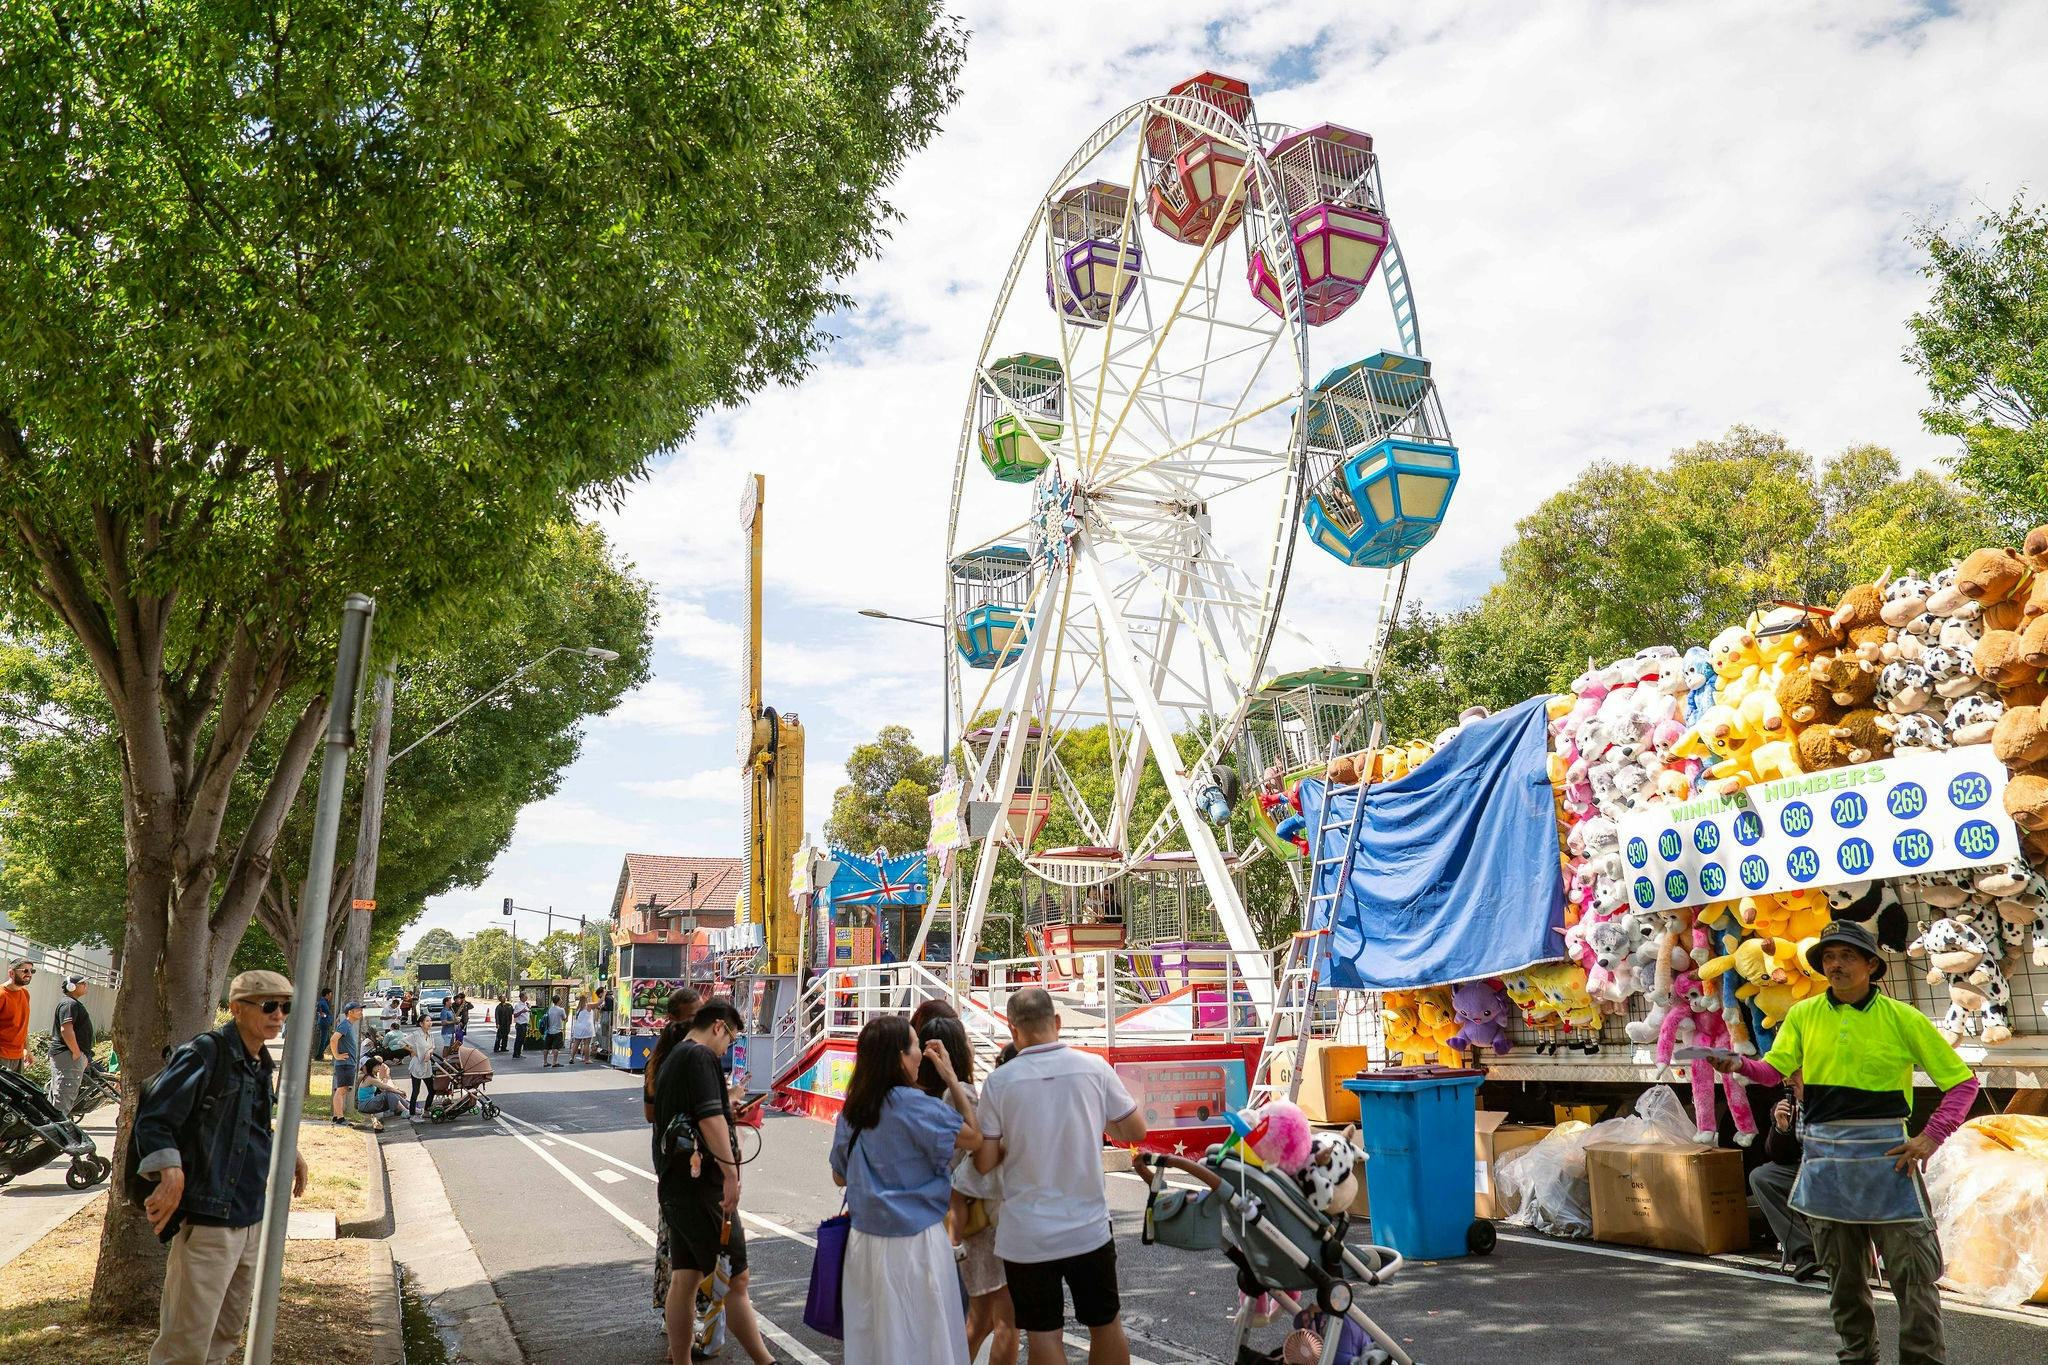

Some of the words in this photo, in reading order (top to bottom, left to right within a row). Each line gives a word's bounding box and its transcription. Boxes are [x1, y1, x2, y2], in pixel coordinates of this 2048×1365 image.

[1628, 841, 1647, 863] 930
[1660, 834, 1681, 857] 801
[1696, 826, 1718, 850] 343
[1736, 816, 1760, 842] 144
[1783, 806, 1811, 832] 686
[1835, 797, 1863, 823] 201
[1891, 787, 1923, 814] 269
[1953, 777, 1987, 804] 523
[1671, 792, 1748, 823] WINNING
[1764, 765, 1886, 802] NUMBERS
[1636, 881, 1653, 903] 758
[1667, 874, 1686, 898] 485
[1702, 867, 1724, 891] 539
[1742, 859, 1766, 885] 930
[1790, 850, 1816, 877] 343
[1841, 843, 1870, 869] 801
[1896, 835, 1929, 861] 758
[1960, 825, 1994, 853] 485
